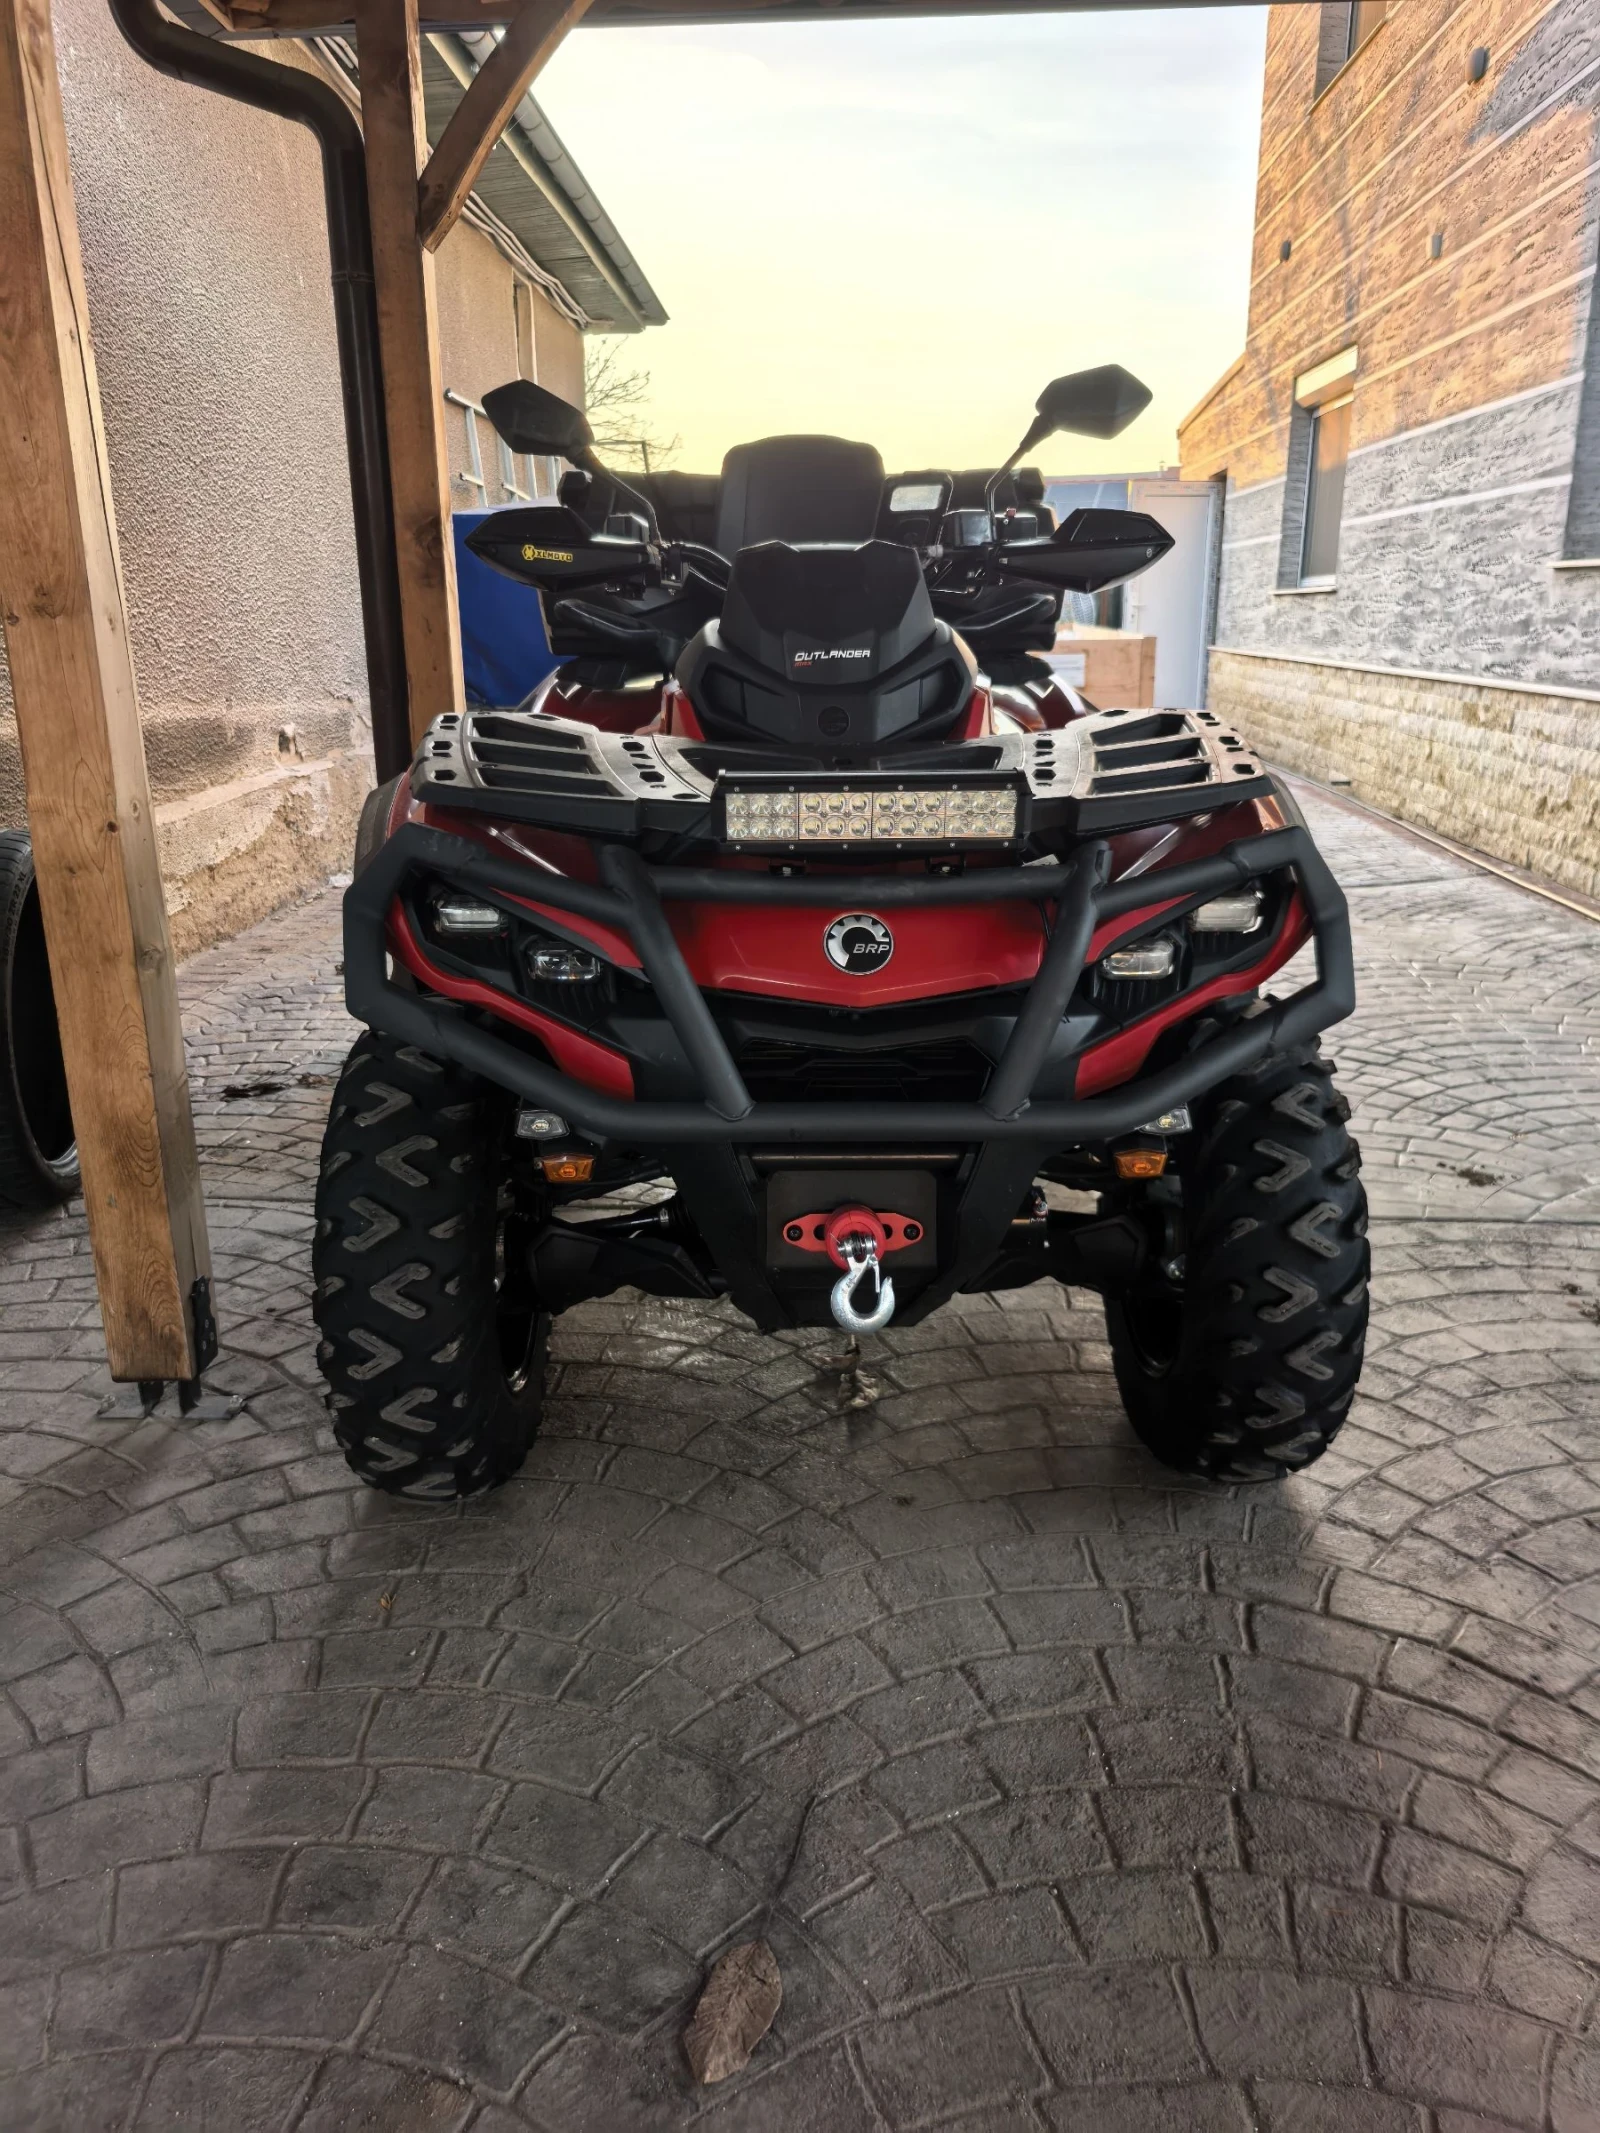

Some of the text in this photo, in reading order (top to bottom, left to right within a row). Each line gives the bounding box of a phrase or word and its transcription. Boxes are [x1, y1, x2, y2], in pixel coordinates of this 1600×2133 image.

[535, 549, 573, 562] XLMOTO
[794, 650, 870, 661] OUTLANDER
[13, 885, 20, 899] 22
[17, 871, 26, 882] XL
[853, 943, 889, 954] BRP
